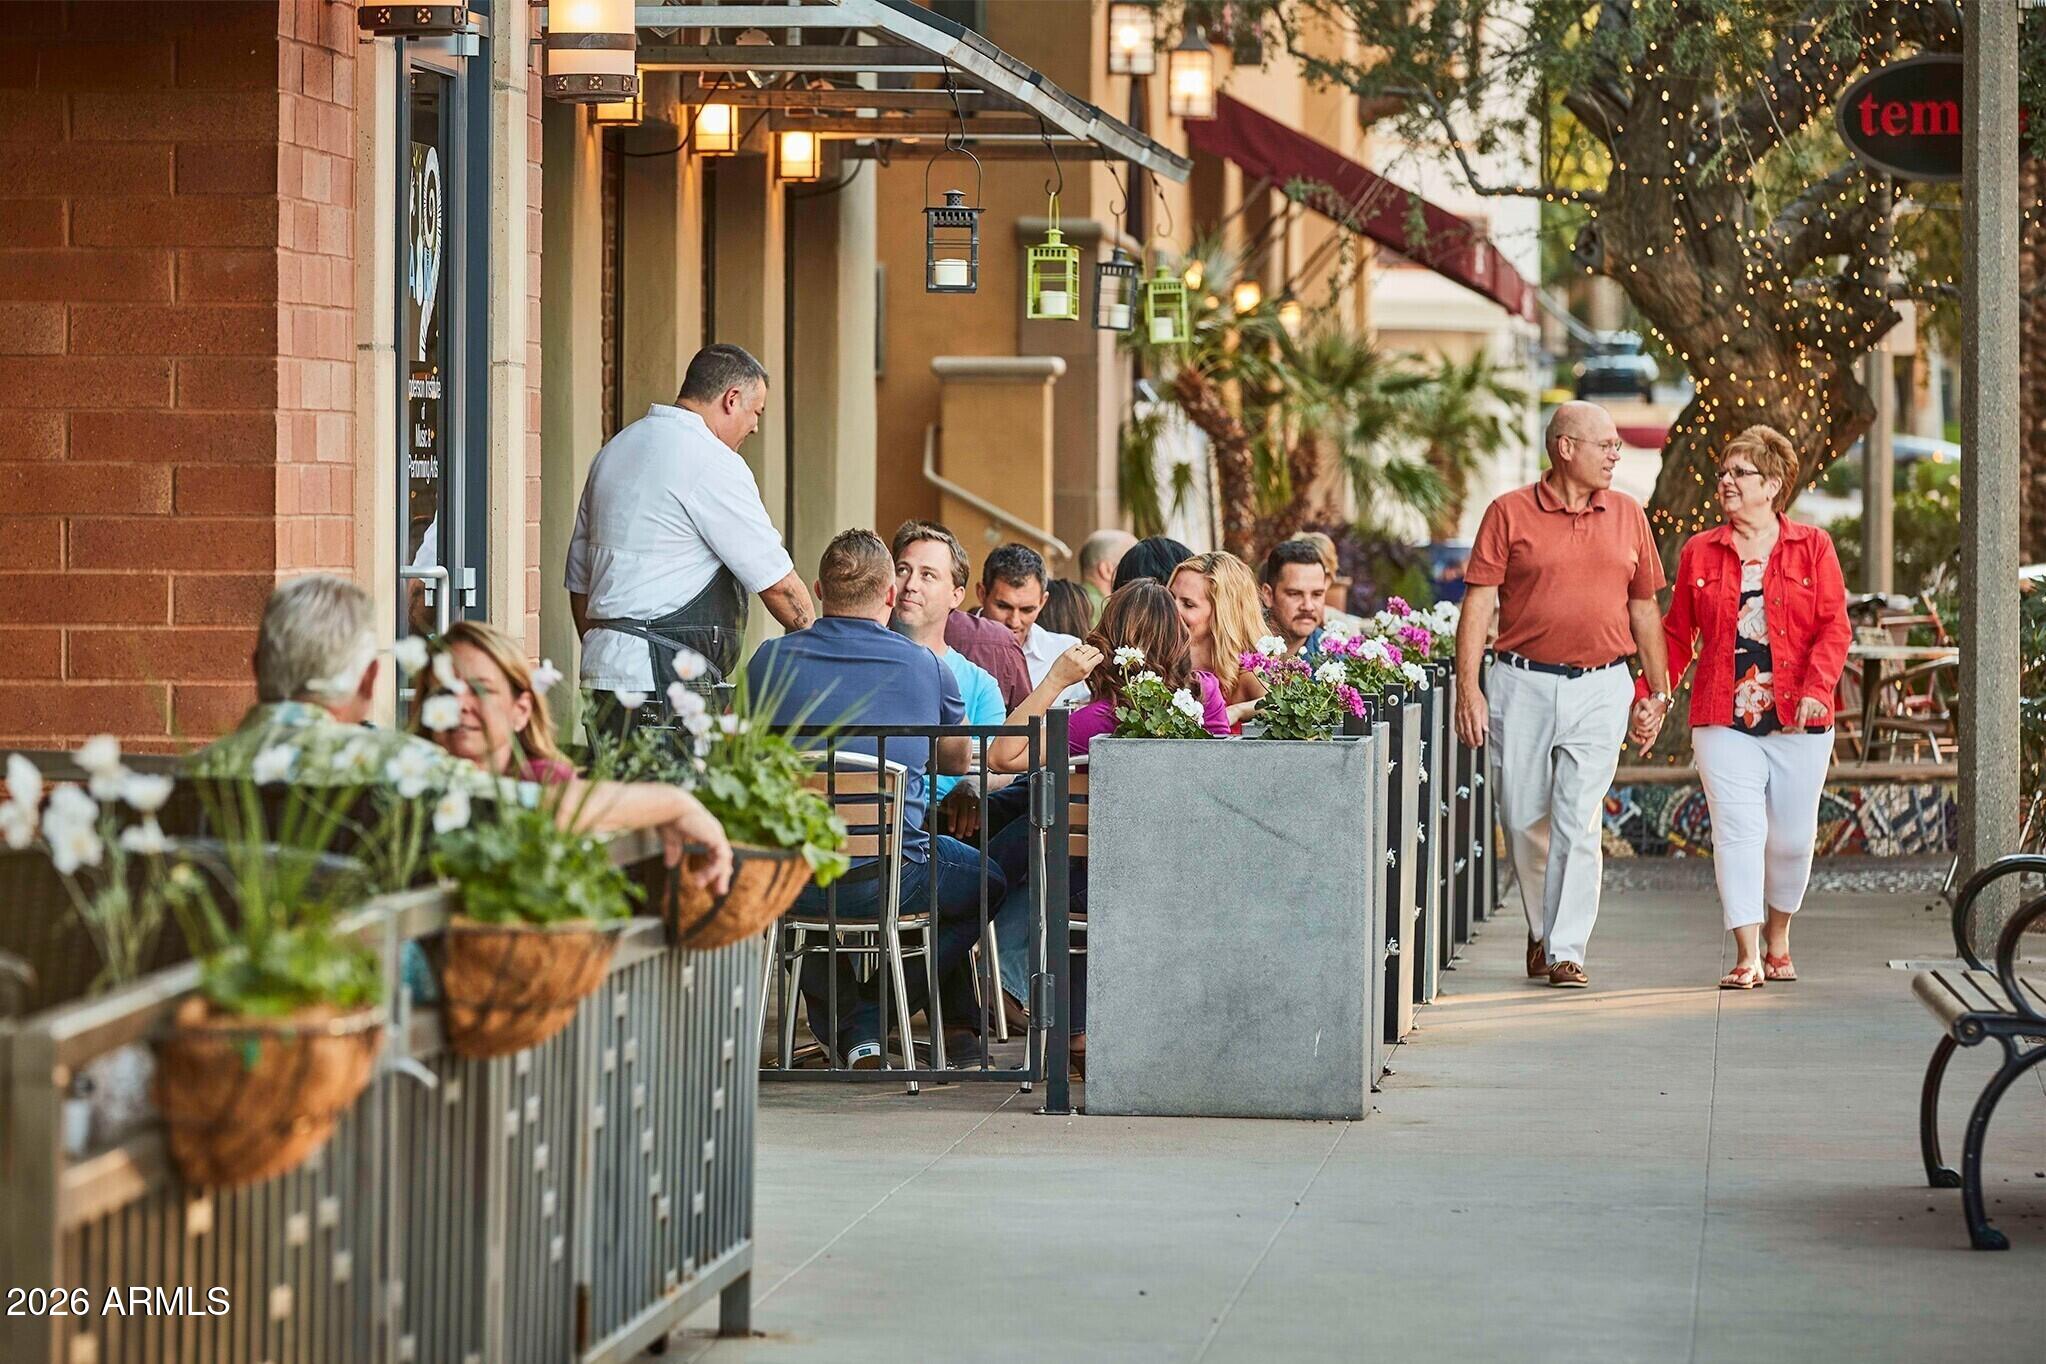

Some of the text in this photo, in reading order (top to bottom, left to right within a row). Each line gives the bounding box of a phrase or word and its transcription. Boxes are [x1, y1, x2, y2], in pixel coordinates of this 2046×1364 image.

[1858, 91, 1962, 137] tem
[415, 423, 427, 447] Music
[408, 453, 430, 485] Performing
